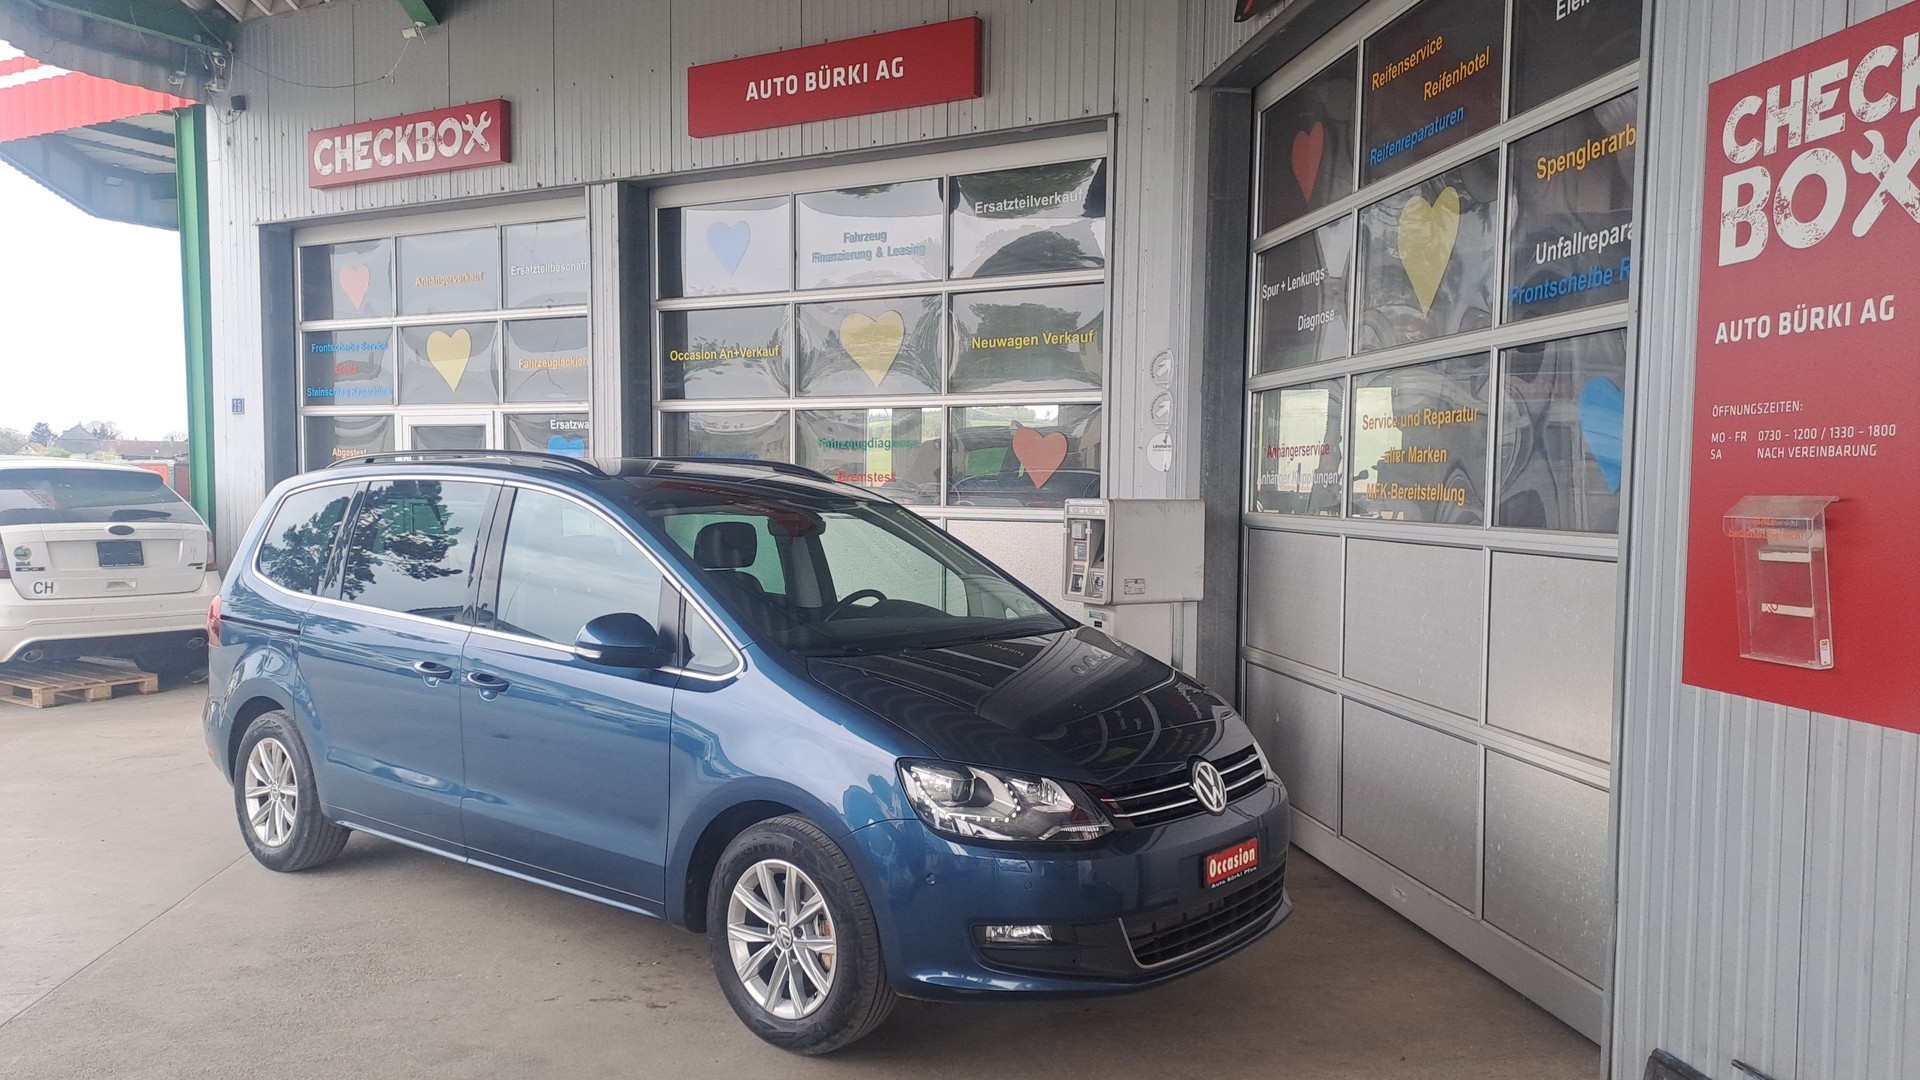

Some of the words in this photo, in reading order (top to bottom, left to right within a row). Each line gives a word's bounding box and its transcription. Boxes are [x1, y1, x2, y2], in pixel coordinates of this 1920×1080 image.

[1371, 36, 1443, 91] Reifenservice
[1423, 45, 1490, 101] Reifenhotel
[745, 75, 798, 101] AUTO
[805, 63, 868, 92] BÜRKI
[875, 56, 904, 81] AG
[313, 110, 492, 176] CHECKBOX
[1369, 106, 1464, 167] Reifenreparaturen
[1536, 123, 1636, 181] Spenglerarb
[974, 188, 1084, 215] Ersatzteilverkauf
[843, 231, 888, 244] Fahrzeug
[812, 249, 873, 263] Finanzierung
[875, 246, 884, 258] &
[887, 243, 926, 257] Leasing
[1262, 283, 1280, 302] Spur
[1281, 280, 1286, 291] +
[1509, 266, 1613, 306] Frontscheibe
[1297, 309, 1335, 332] Diagnose
[1714, 315, 1771, 345] AUTO
[1778, 302, 1851, 336] BÜRKI
[1860, 294, 1895, 324] AG
[971, 333, 1039, 350] Neuwagen
[1042, 329, 1096, 345] Verkauf
[519, 356, 588, 369] Fahrzeuglackier
[670, 349, 717, 361] Occasion
[719, 344, 779, 359] An+Verkauf
[1362, 412, 1399, 431] Service
[1401, 410, 1420, 427] und
[1423, 405, 1479, 429] Reparatur
[1712, 400, 1803, 417] ÖFFNUNGSZEITEN:
[1711, 431, 1726, 444] MO
[1734, 430, 1747, 442] FR
[1758, 429, 1782, 442] 0730
[1793, 428, 1817, 441] 1200
[1820, 427, 1826, 441] /
[1829, 426, 1854, 439] 1330
[1867, 424, 1896, 438] 1800
[1384, 446, 1406, 463] aller
[1408, 444, 1448, 463] Marken
[1710, 448, 1722, 460] SA
[1757, 447, 1785, 459] NACH
[1787, 444, 1877, 459] VEREINBARUNG
[837, 470, 897, 483] Bremstest
[1366, 482, 1466, 507] MFK-Bereitstellung
[33, 581, 54, 594] CH
[1209, 847, 1255, 878] Occasion
